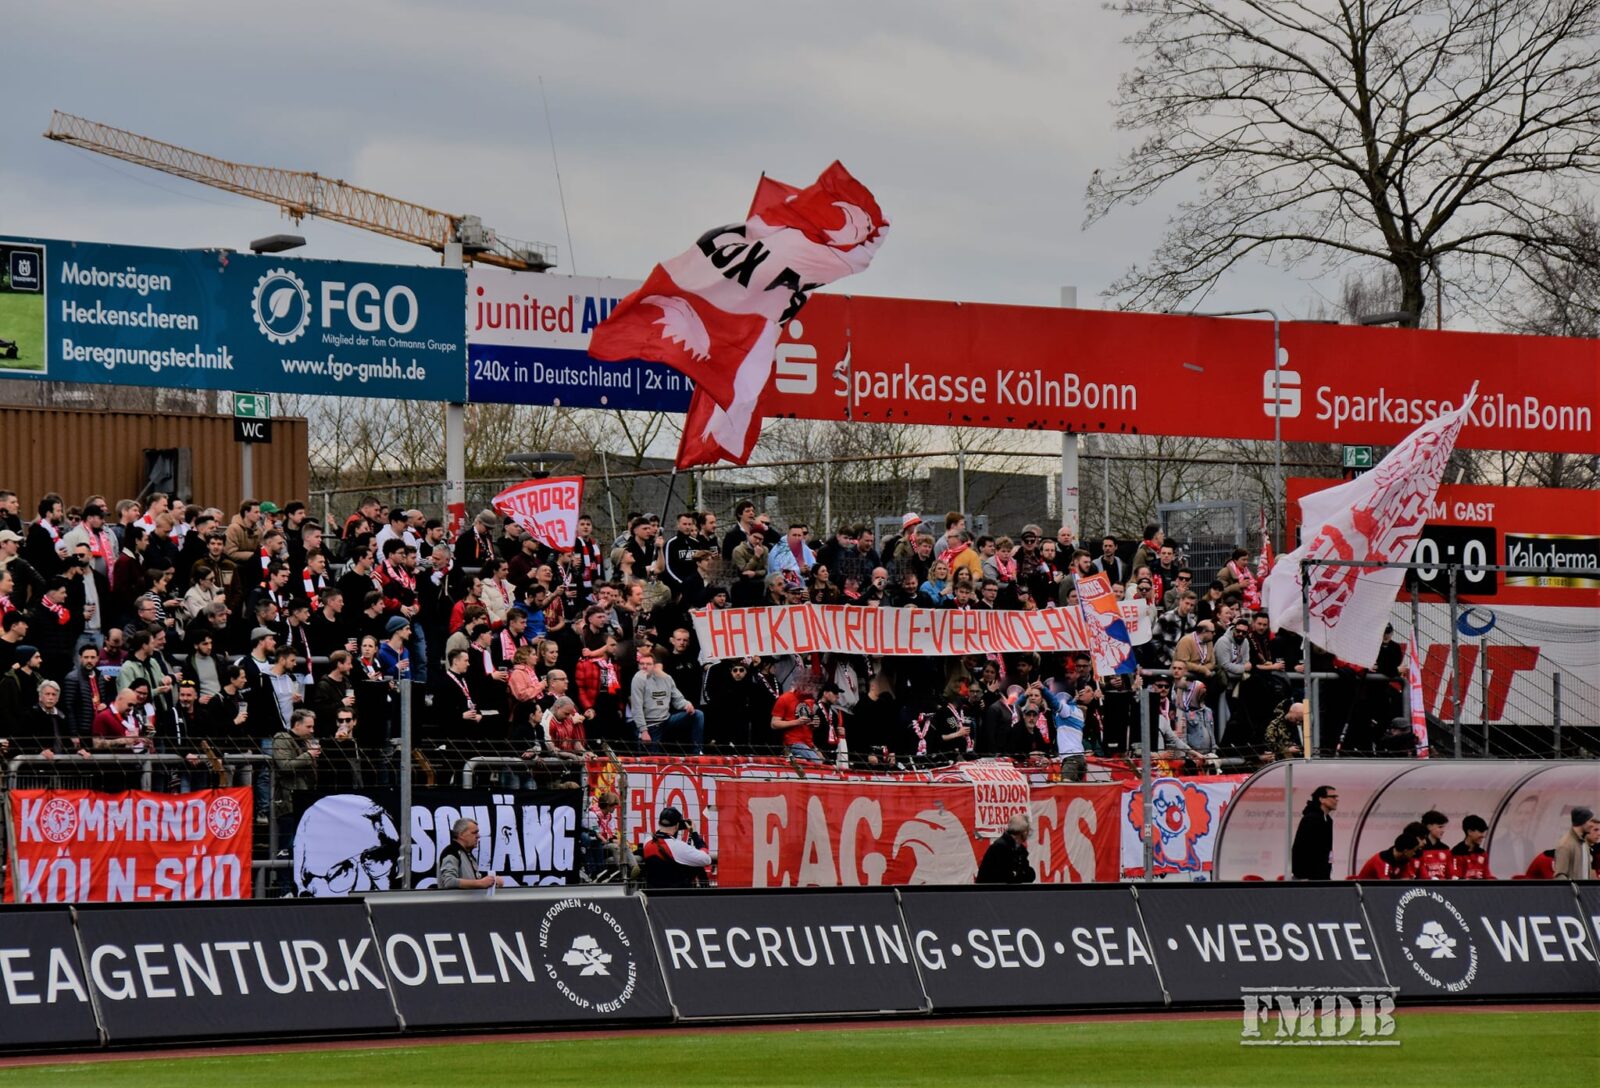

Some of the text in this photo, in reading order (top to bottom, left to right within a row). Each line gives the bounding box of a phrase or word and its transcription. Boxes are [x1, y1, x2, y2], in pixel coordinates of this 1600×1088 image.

[61, 261, 172, 293] Motorsägen
[61, 301, 199, 331] Heckenscheren
[320, 280, 419, 334] FGO
[475, 286, 574, 334] junited
[62, 338, 234, 372] Beregnungstechnik
[322, 333, 457, 353] Mitglied der Tom Ortmanns Gruppe
[281, 353, 426, 383] www.fgo-gmbh.de
[474, 359, 510, 382] 240x
[515, 361, 528, 383] in
[533, 362, 632, 389] Deutschland
[645, 369, 663, 390] 2x
[667, 370, 680, 391] in
[834, 362, 1138, 411] Sparkasse KölnBonn
[241, 421, 265, 439] WC
[1316, 386, 1593, 432] Sparkasse KölnBonn
[1454, 502, 1496, 522] GAST
[1508, 541, 1598, 570] Kaloderma
[976, 784, 1028, 804] STADION
[18, 845, 242, 903] KÖLN-SÜD
[539, 898, 582, 948] NEUE FORMEN
[587, 902, 631, 948] AD GROUP
[1395, 888, 1428, 933] NEUE FORMEN
[1431, 891, 1470, 933] AD GROUP
[544, 963, 590, 1009] AD GROUP
[596, 961, 637, 1013] NEUE FORMEN
[1402, 946, 1442, 988] AD GROUP
[1446, 944, 1479, 992] NEUE FORMEN
